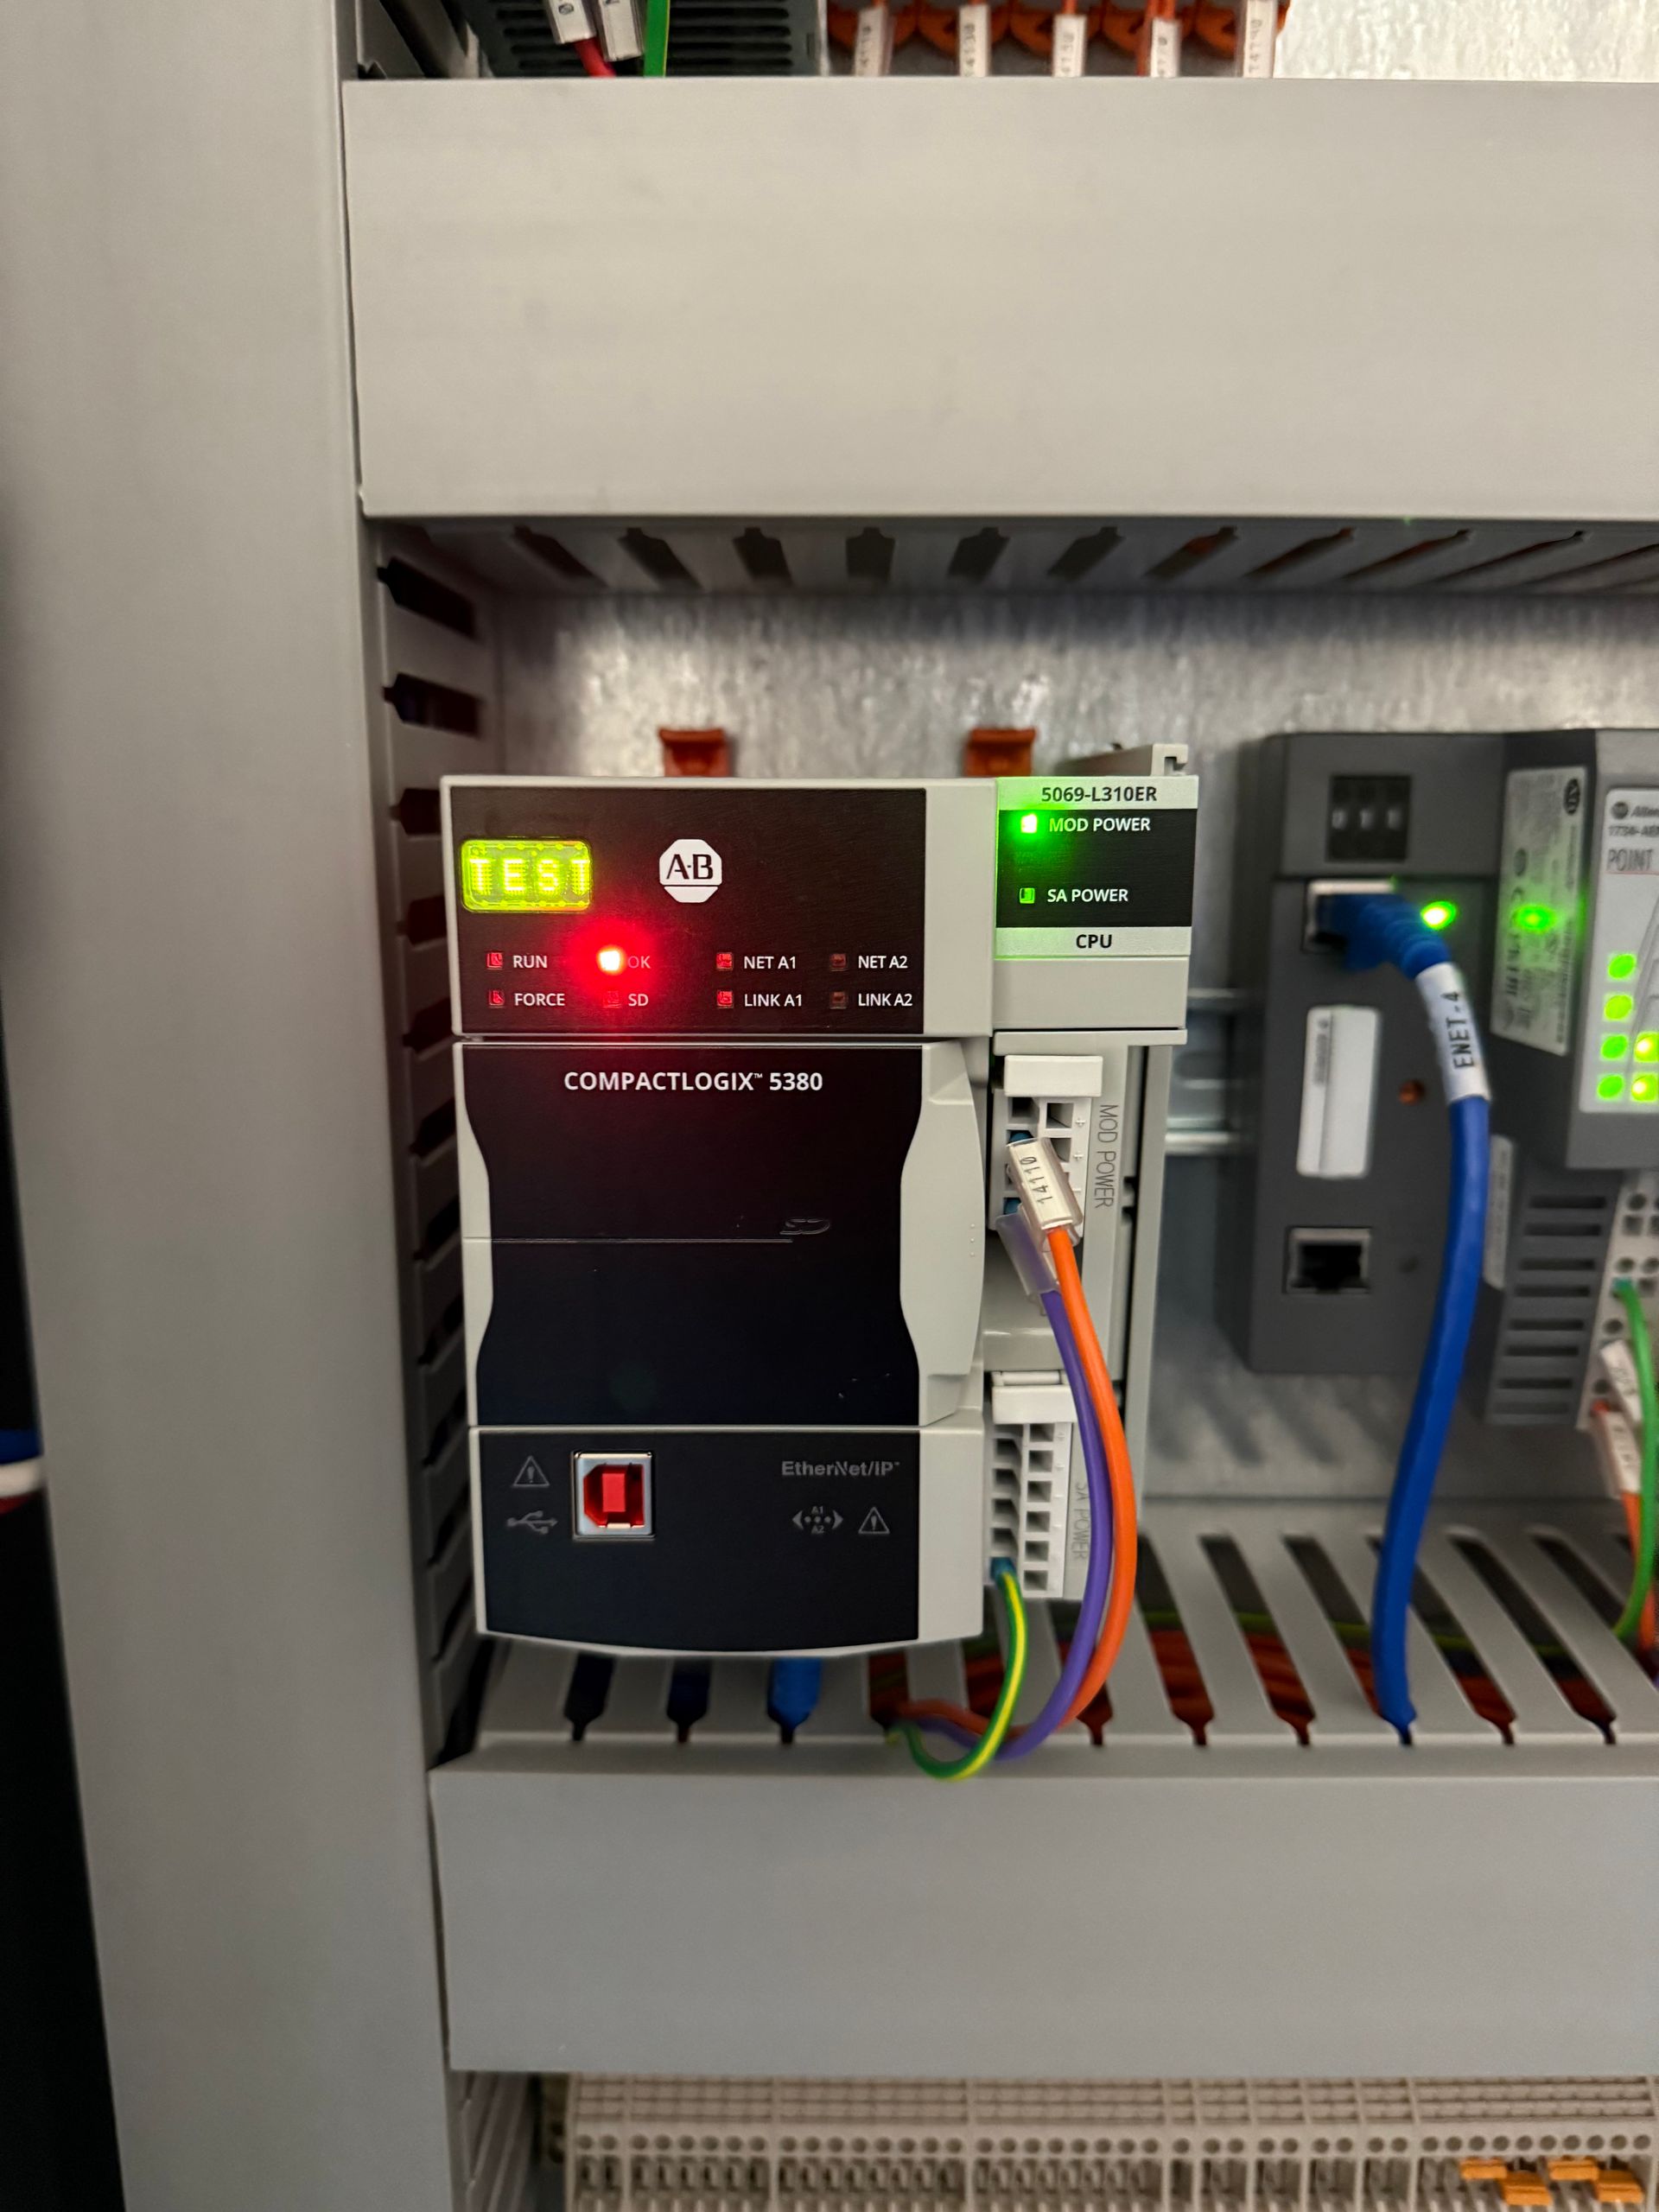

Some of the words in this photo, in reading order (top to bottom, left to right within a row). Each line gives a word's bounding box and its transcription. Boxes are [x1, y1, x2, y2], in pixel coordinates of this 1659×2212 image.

[1041, 786, 1157, 802] 5069-L310ER
[1049, 817, 1089, 832] MOD
[1092, 817, 1151, 831] POWER
[469, 858, 590, 896] TEST
[1047, 888, 1068, 902] SA
[1071, 888, 1128, 902] POWER
[1076, 934, 1113, 949] CPU
[512, 955, 548, 969] RUN
[627, 956, 651, 969] OK
[743, 956, 773, 969] NET
[778, 956, 796, 969] A1
[858, 956, 887, 969] NET
[889, 956, 908, 969] A2
[514, 993, 565, 1007] FORCE
[628, 993, 649, 1007] SD
[744, 994, 780, 1007] LINK
[784, 994, 803, 1007] A1
[858, 993, 891, 1007] LINK
[893, 993, 912, 1007] A2
[1440, 991, 1474, 1069] ENET-4
[769, 1072, 823, 1091] 5380
[1096, 1104, 1119, 1143] MOD
[1020, 1155, 1052, 1205] 14110
[1094, 1150, 1117, 1209] POWER
[810, 1505, 823, 1515] A1
[810, 1525, 825, 1534] A2
